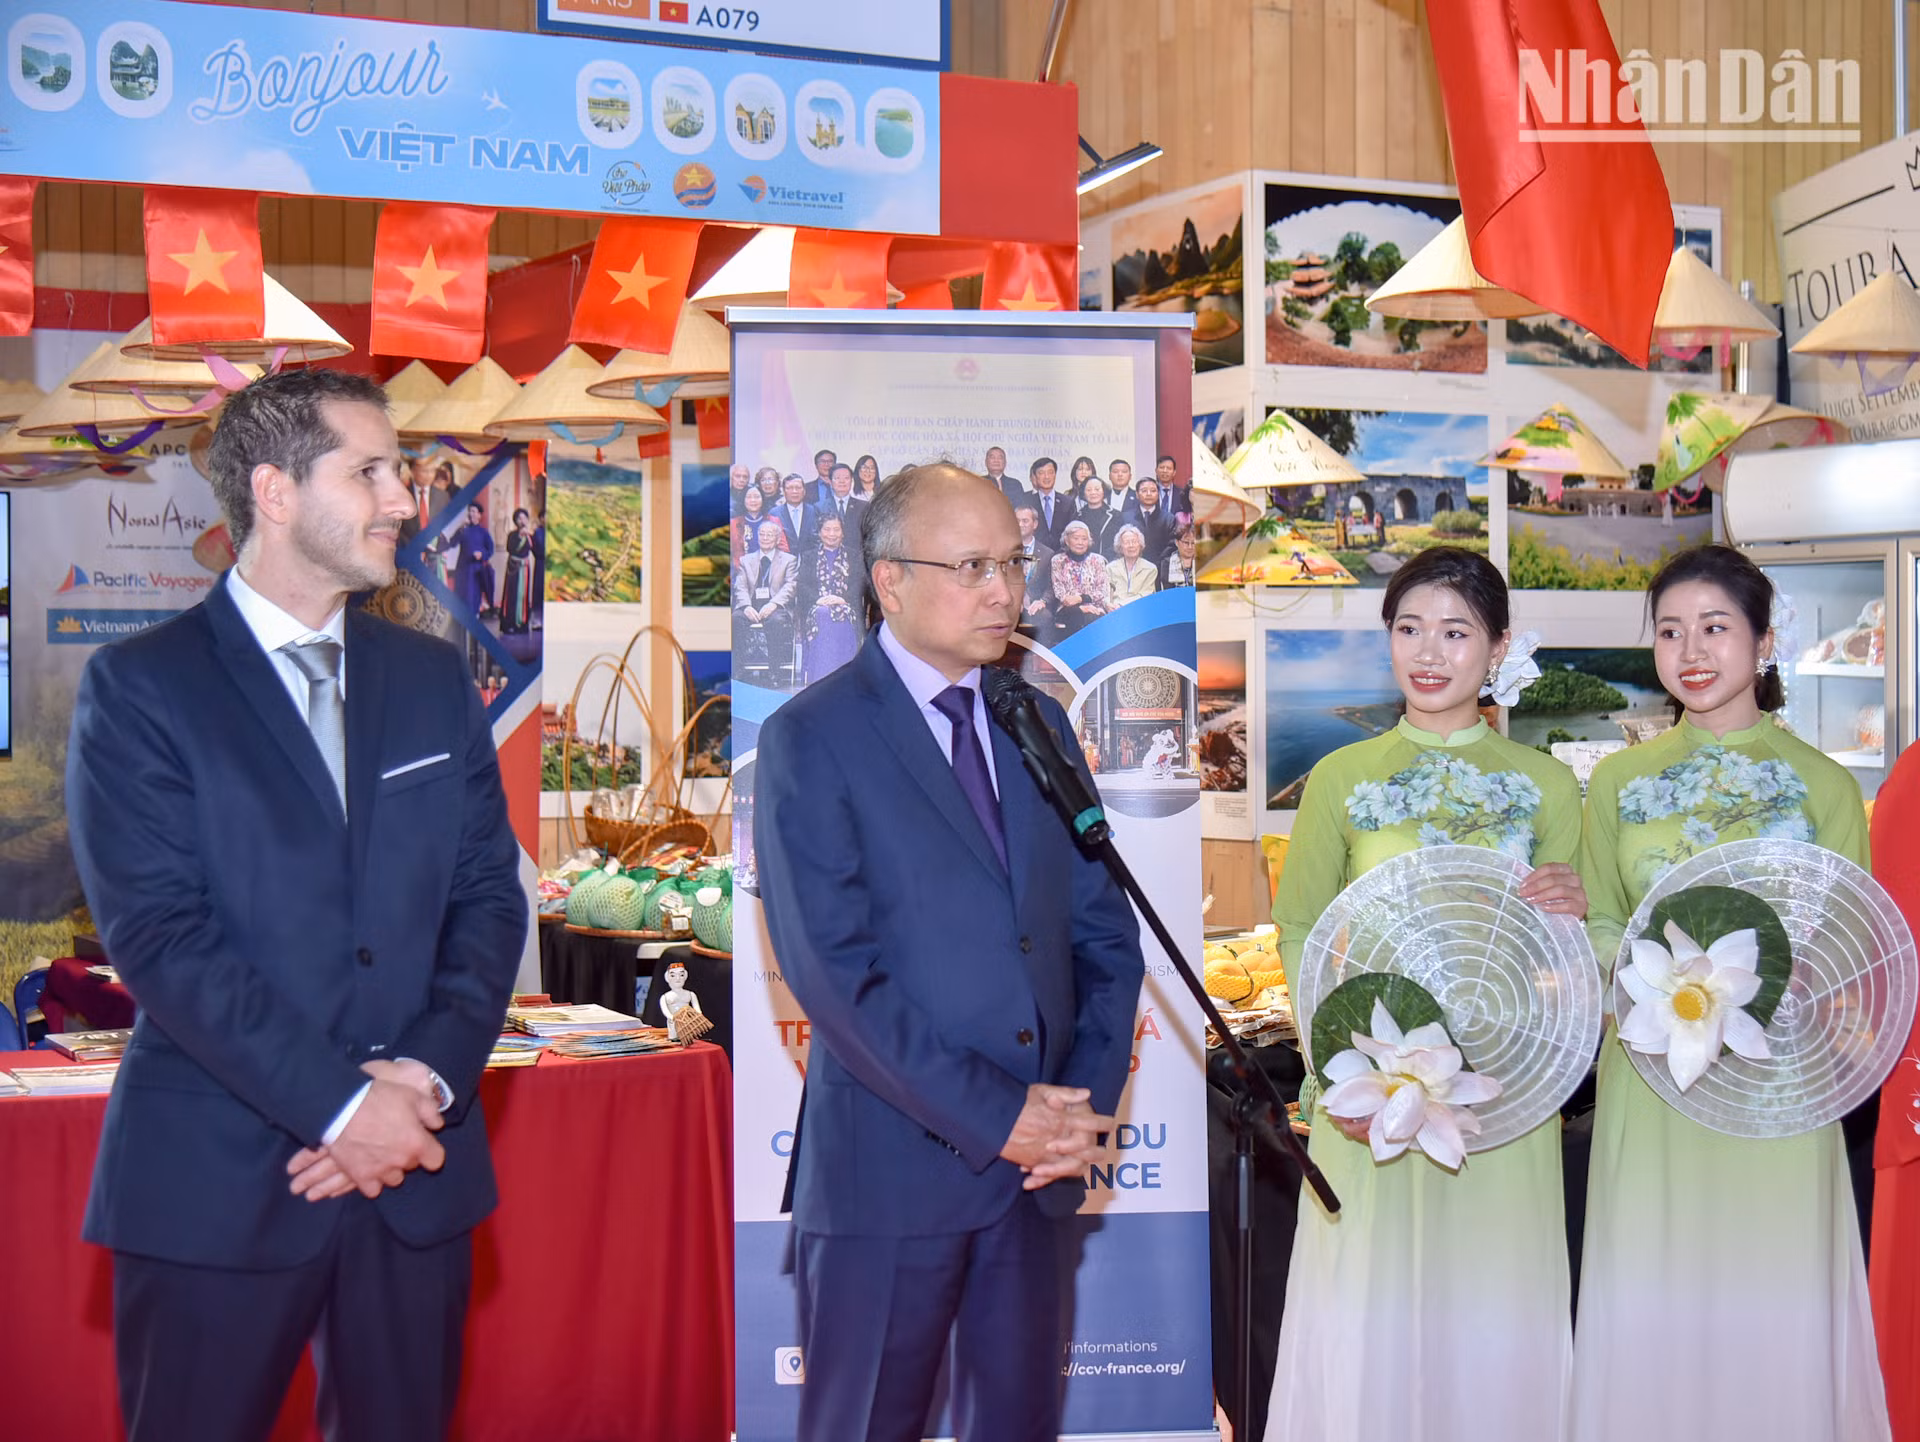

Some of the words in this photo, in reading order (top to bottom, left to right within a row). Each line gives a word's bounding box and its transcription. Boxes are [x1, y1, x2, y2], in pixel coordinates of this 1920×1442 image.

[696, 5, 759, 31] A079
[188, 39, 450, 134] Bonjour
[337, 121, 456, 172] VIỆT
[470, 136, 590, 176] NAM
[768, 186, 843, 203] Vietravel
[1858, 379, 1920, 414] SETTEMB
[149, 443, 186, 456] APC
[93, 570, 147, 587] Pacific
[83, 619, 158, 633] VietnamA
[773, 1020, 812, 1047] TR
[1134, 1007, 1162, 1041] Á
[1116, 1123, 1166, 1150] DU
